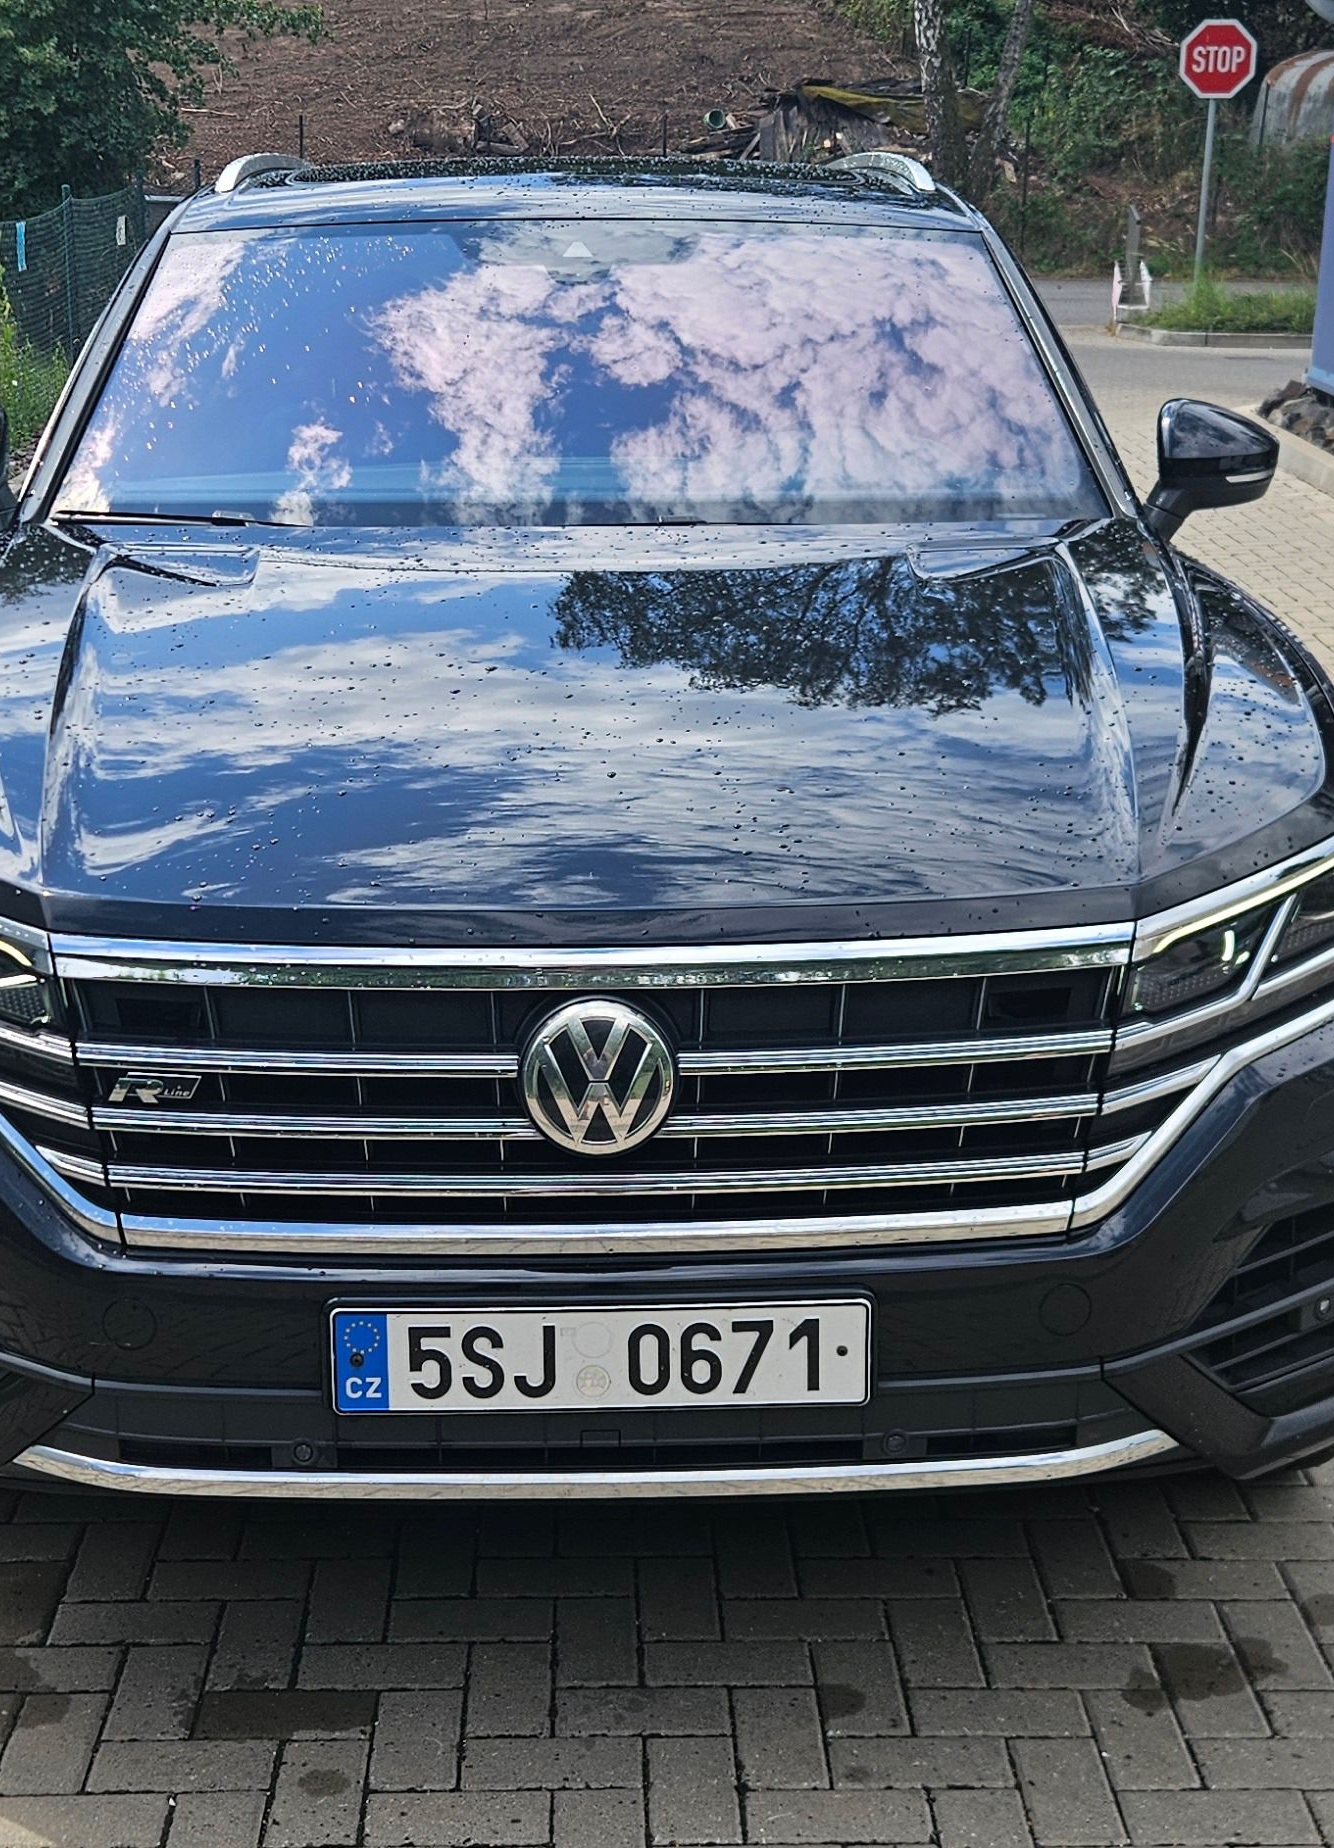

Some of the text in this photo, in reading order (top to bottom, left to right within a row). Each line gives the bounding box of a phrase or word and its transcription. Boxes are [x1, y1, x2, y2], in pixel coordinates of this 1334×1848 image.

[1191, 46, 1246, 73] STOP
[407, 1317, 820, 1399] 5SJ 0671
[345, 1376, 383, 1399] CZ
